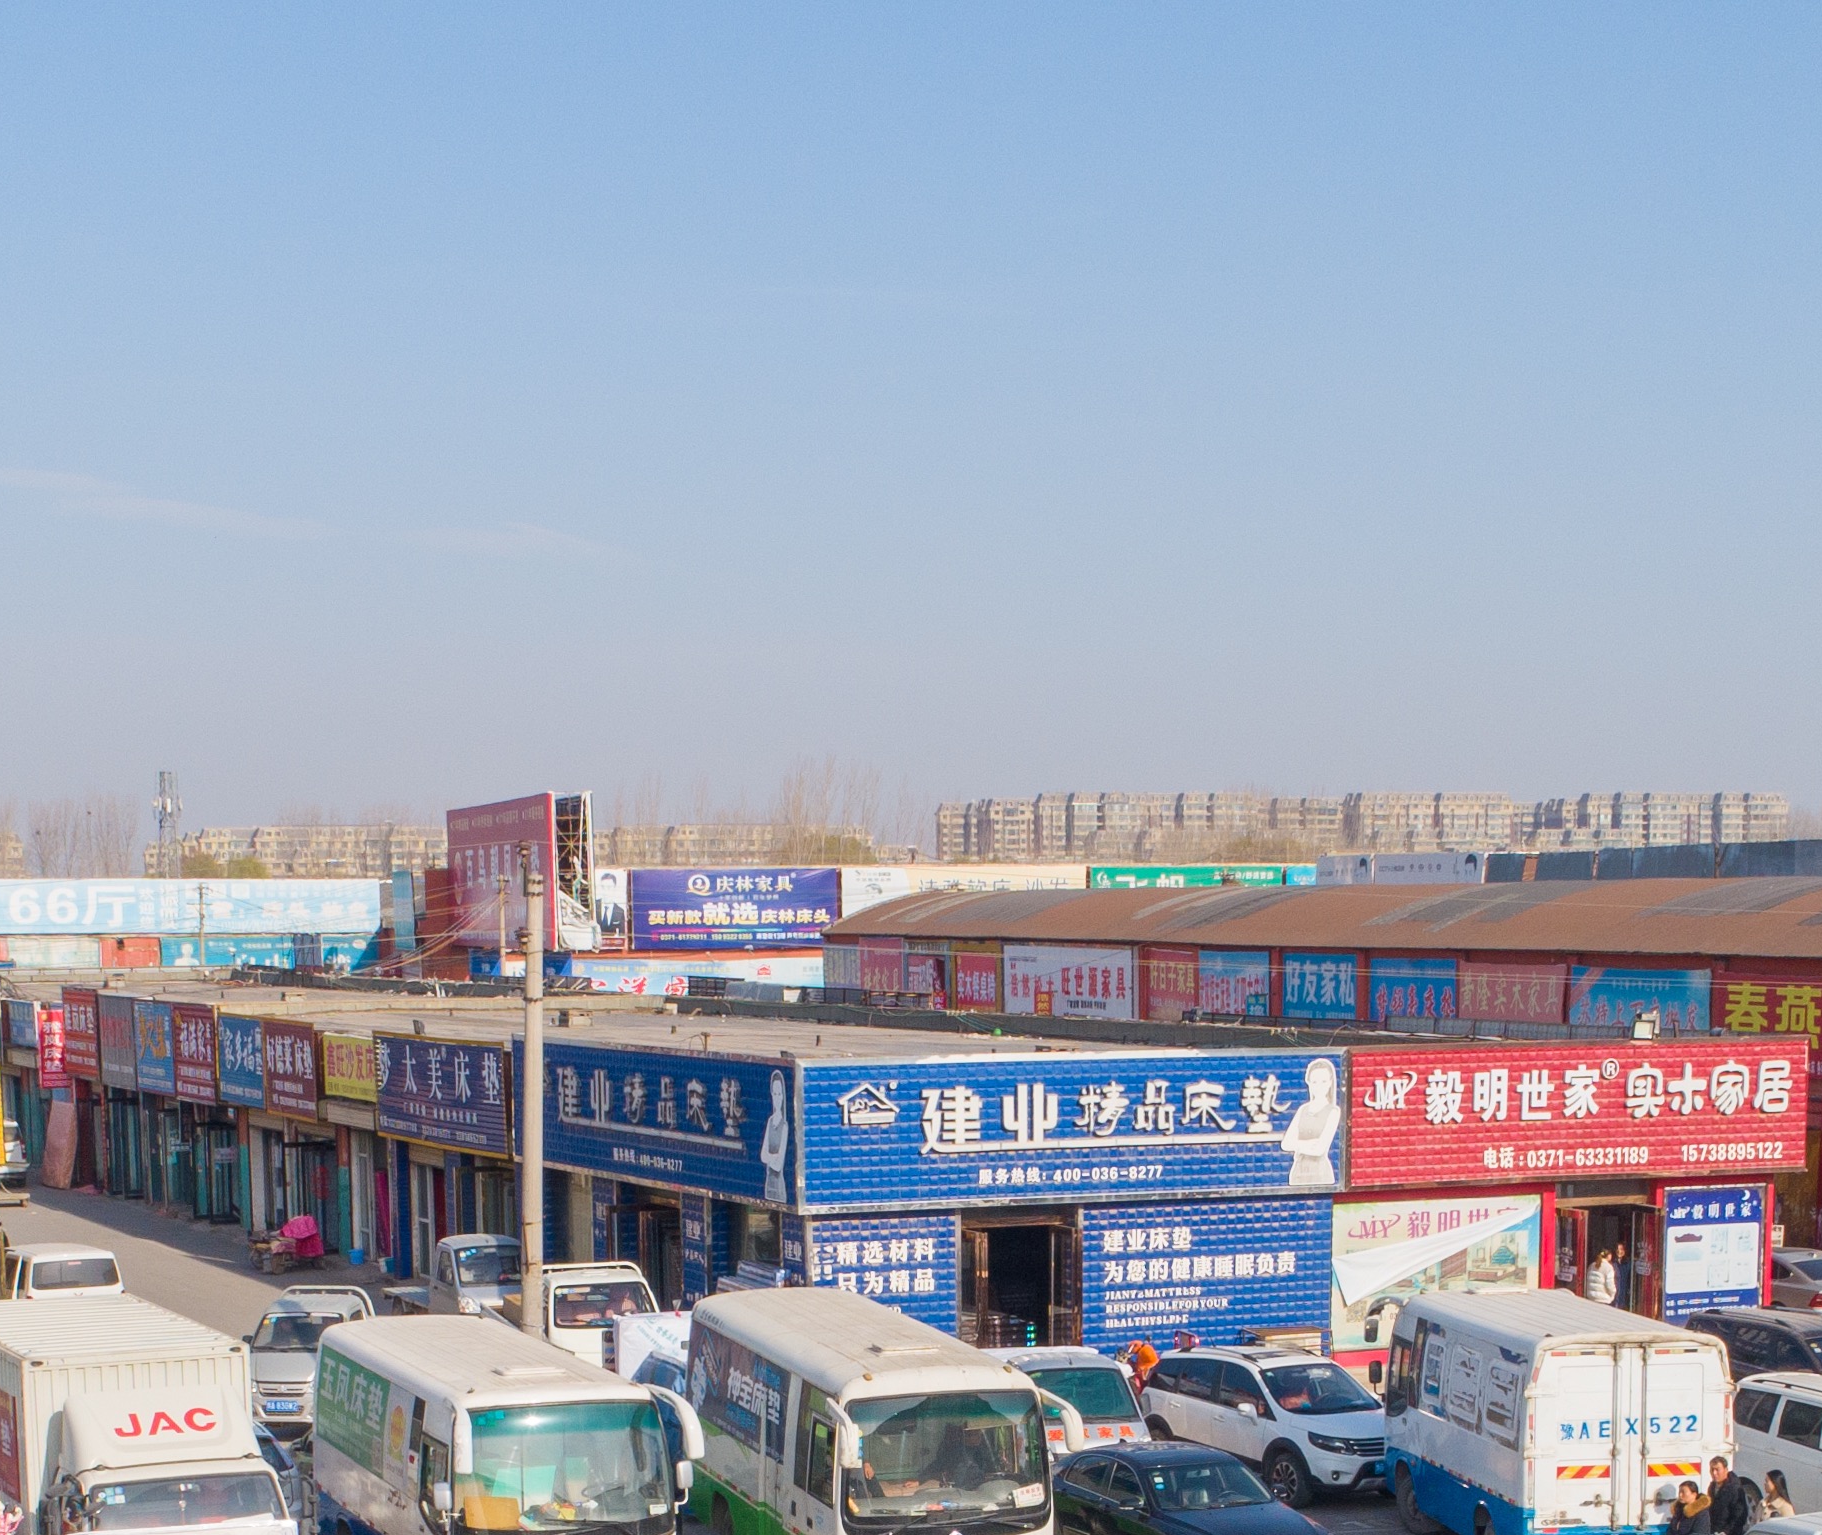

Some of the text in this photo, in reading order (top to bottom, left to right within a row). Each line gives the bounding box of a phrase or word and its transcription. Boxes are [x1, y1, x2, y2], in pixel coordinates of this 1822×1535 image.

[716, 875, 793, 893] 庆林家具
[648, 901, 831, 926] 买新款就选庆林床头
[1284, 960, 1356, 1007] 好友家私
[1425, 1064, 1601, 1124] 毅明世家
[1627, 1058, 1794, 1119] 实木家居
[1681, 1140, 1783, 1162] 15738895122
[837, 1237, 936, 1265] 精选材料
[1103, 1227, 1192, 1251] 建业床垫
[838, 1268, 936, 1294] 只为精品
[1104, 1251, 1296, 1284] 为您的健康睡眠负责
[114, 1406, 218, 1437] JAC
